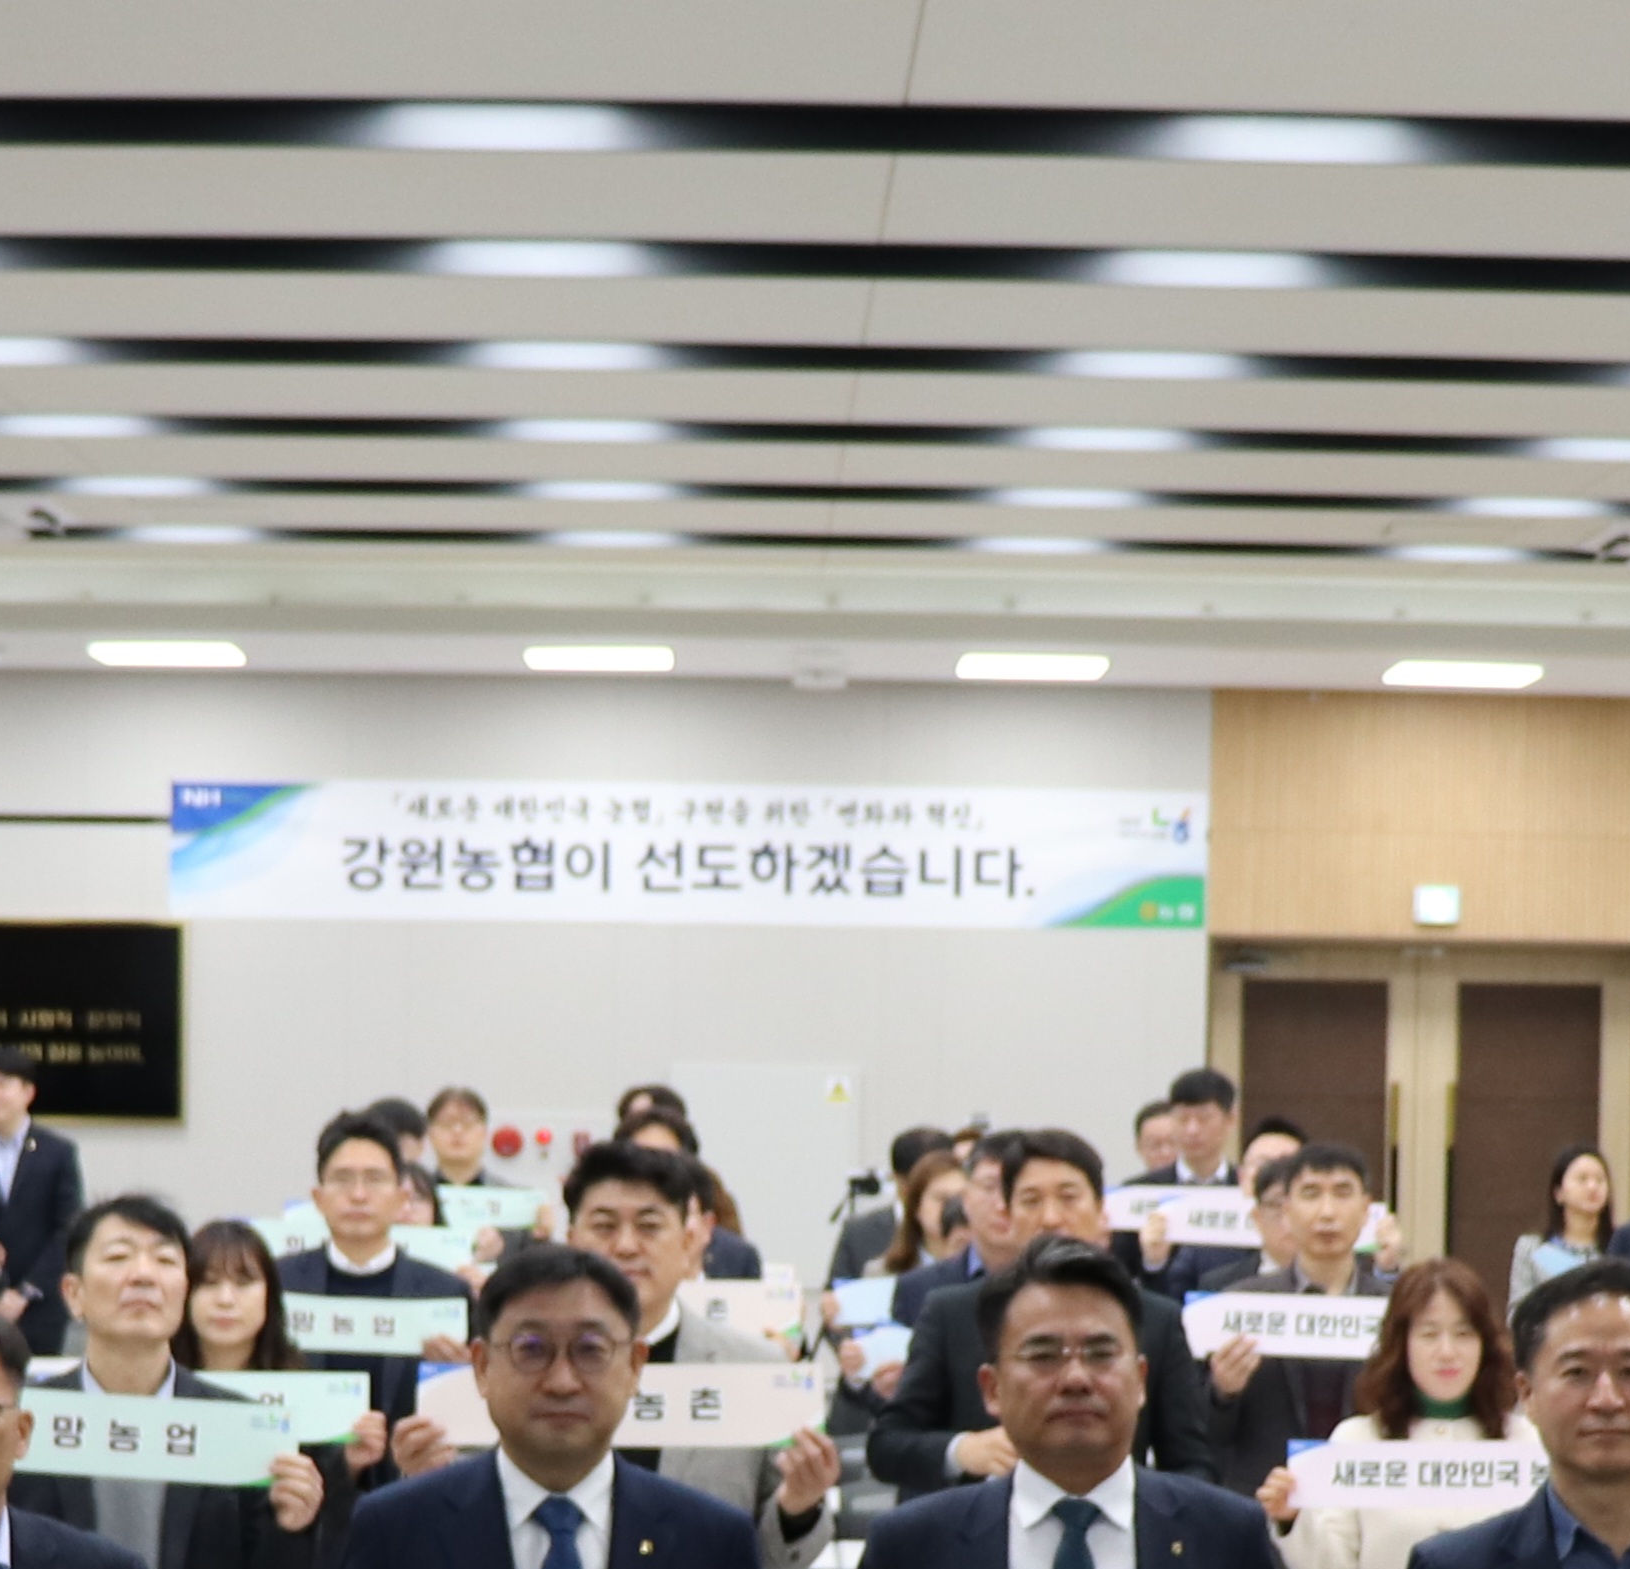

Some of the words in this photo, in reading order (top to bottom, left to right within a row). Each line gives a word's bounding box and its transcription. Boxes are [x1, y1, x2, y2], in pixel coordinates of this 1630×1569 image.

[342, 837, 612, 894] 강원농협이
[637, 838, 1035, 898] 선도하겠습니다.
[1222, 1309, 1288, 1335] 새로운
[1331, 1460, 1407, 1488] 새로운
[1417, 1460, 1520, 1488] 대한민국
